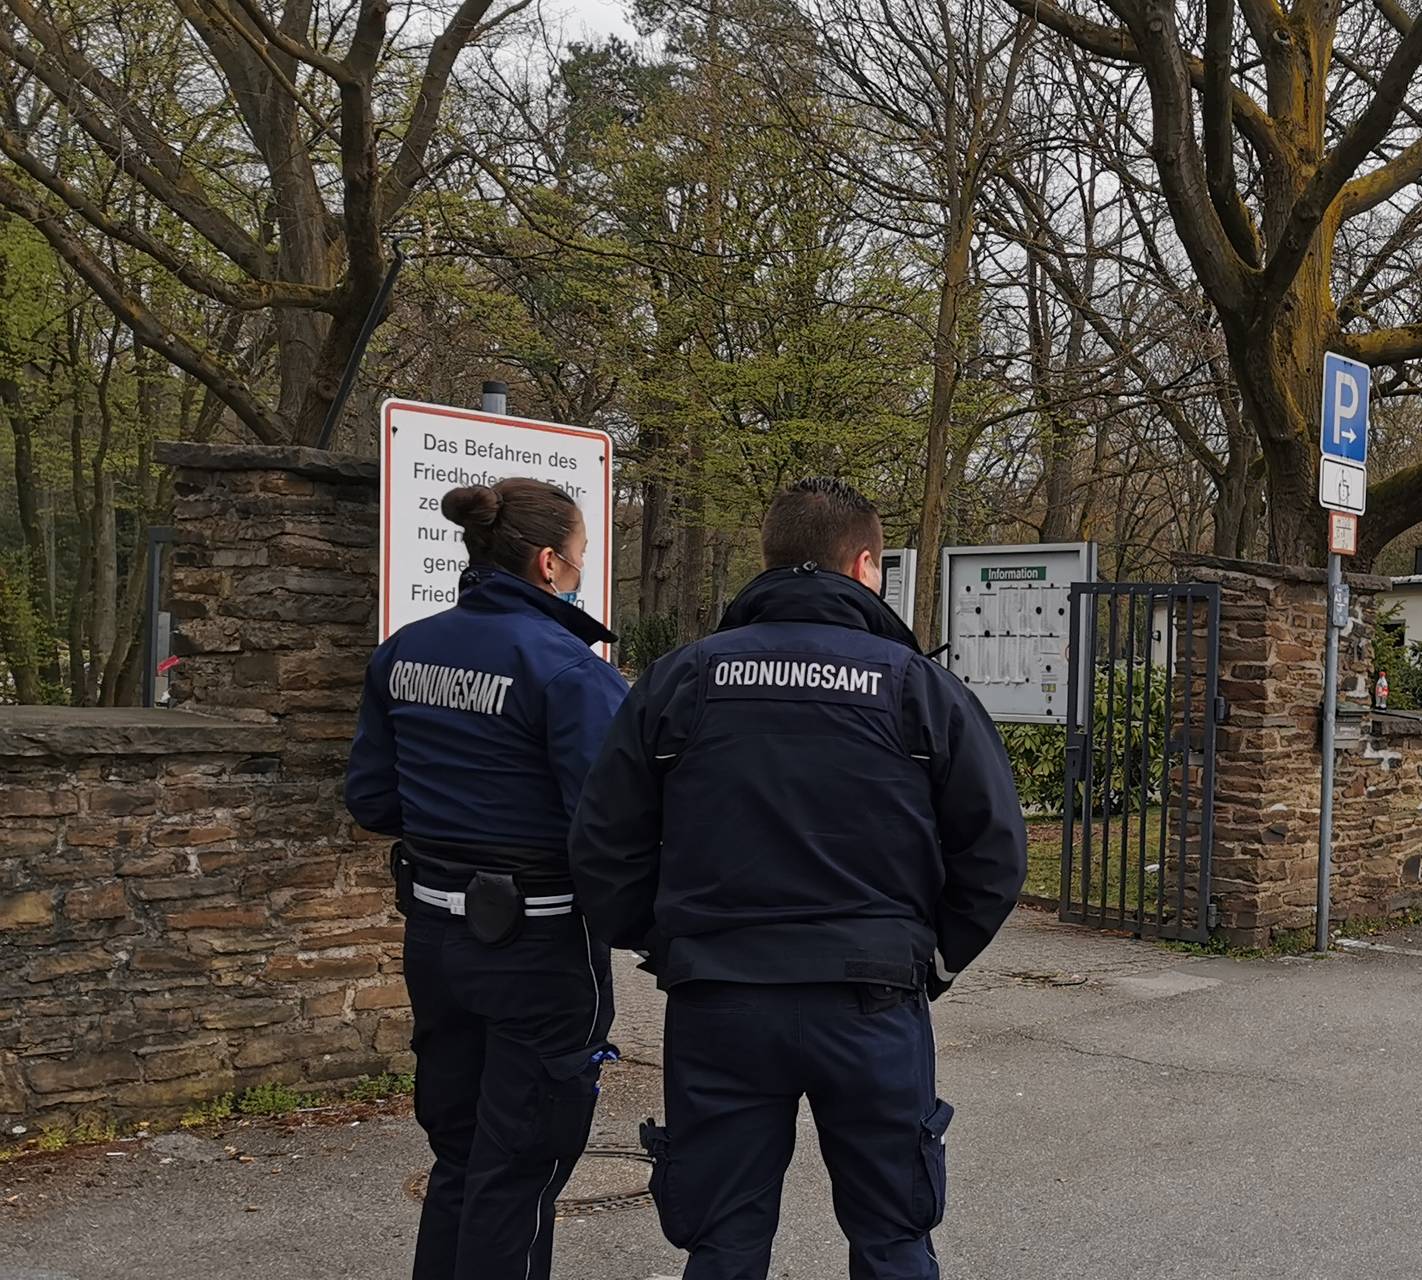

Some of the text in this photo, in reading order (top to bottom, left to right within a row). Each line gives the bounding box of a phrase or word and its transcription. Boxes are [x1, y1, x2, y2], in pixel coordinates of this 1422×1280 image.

[1333, 370, 1359, 445] P
[423, 433, 578, 470] Das Befahren des
[417, 527, 448, 542] nur
[988, 567, 1039, 580] Information
[388, 659, 514, 716] ORDNUNGSAMT
[714, 660, 883, 697] ORDNUNGSAMT
